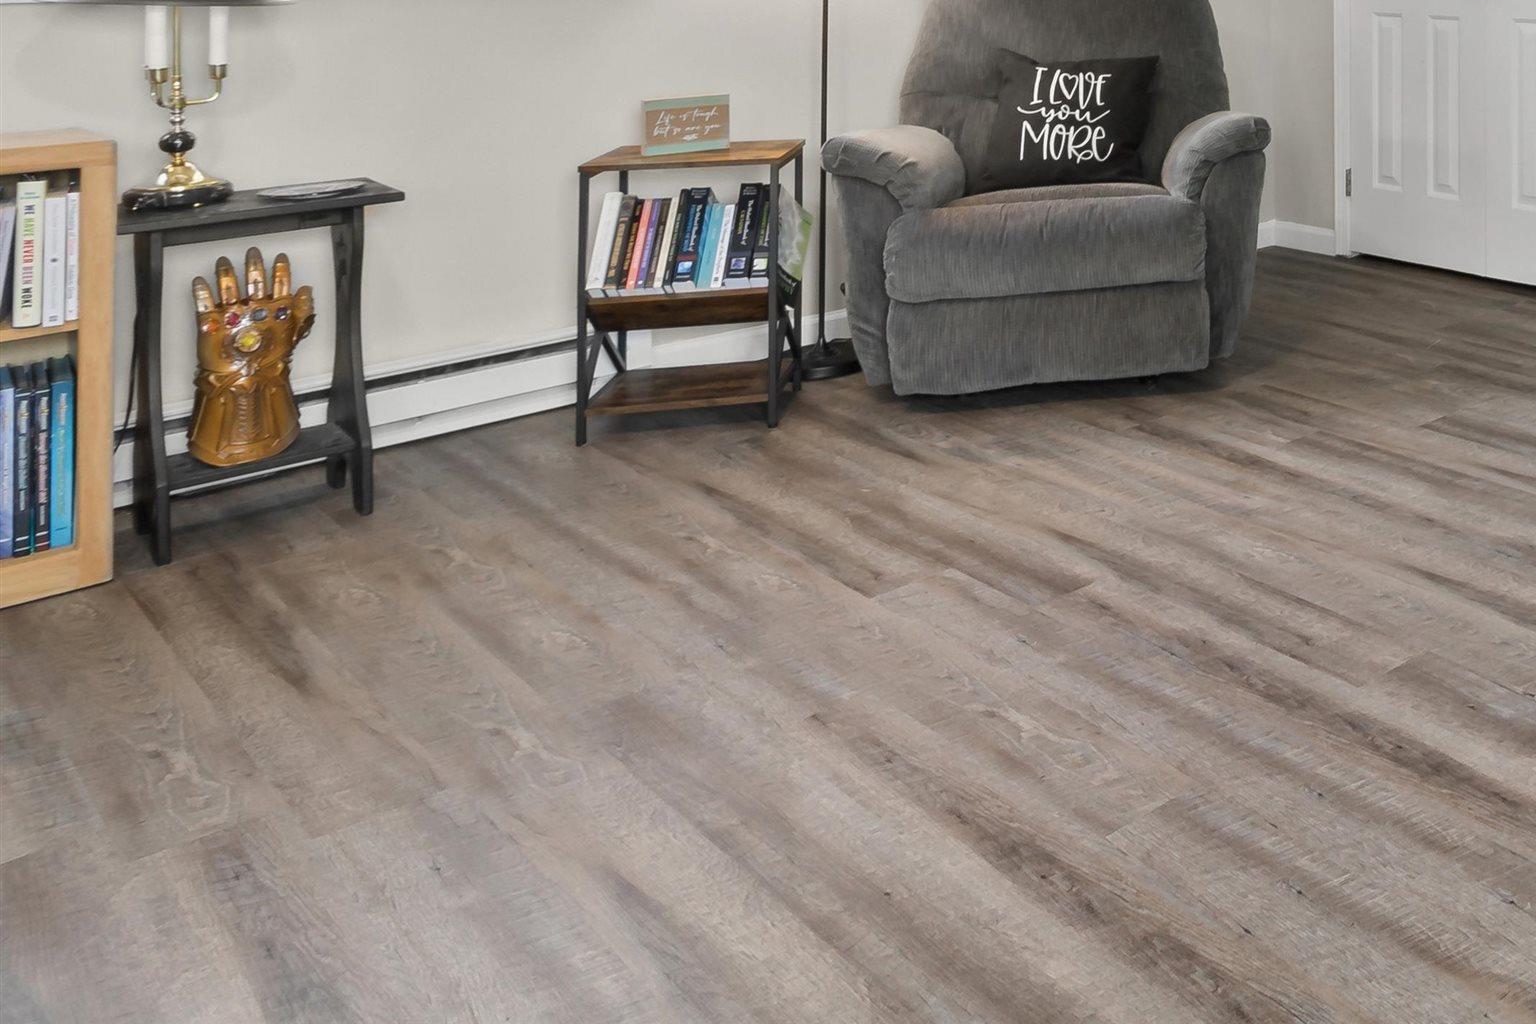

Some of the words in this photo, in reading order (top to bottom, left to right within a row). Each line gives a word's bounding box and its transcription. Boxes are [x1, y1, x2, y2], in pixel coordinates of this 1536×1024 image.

[1030, 67, 1048, 106] I
[1017, 103, 1111, 123] you
[1019, 121, 1115, 164] MORE
[24, 204, 36, 215] WE
[23, 218, 35, 237] HAVE
[23, 239, 35, 264] NEVER
[22, 266, 34, 285] BEEN
[20, 287, 33, 309] WOKE
